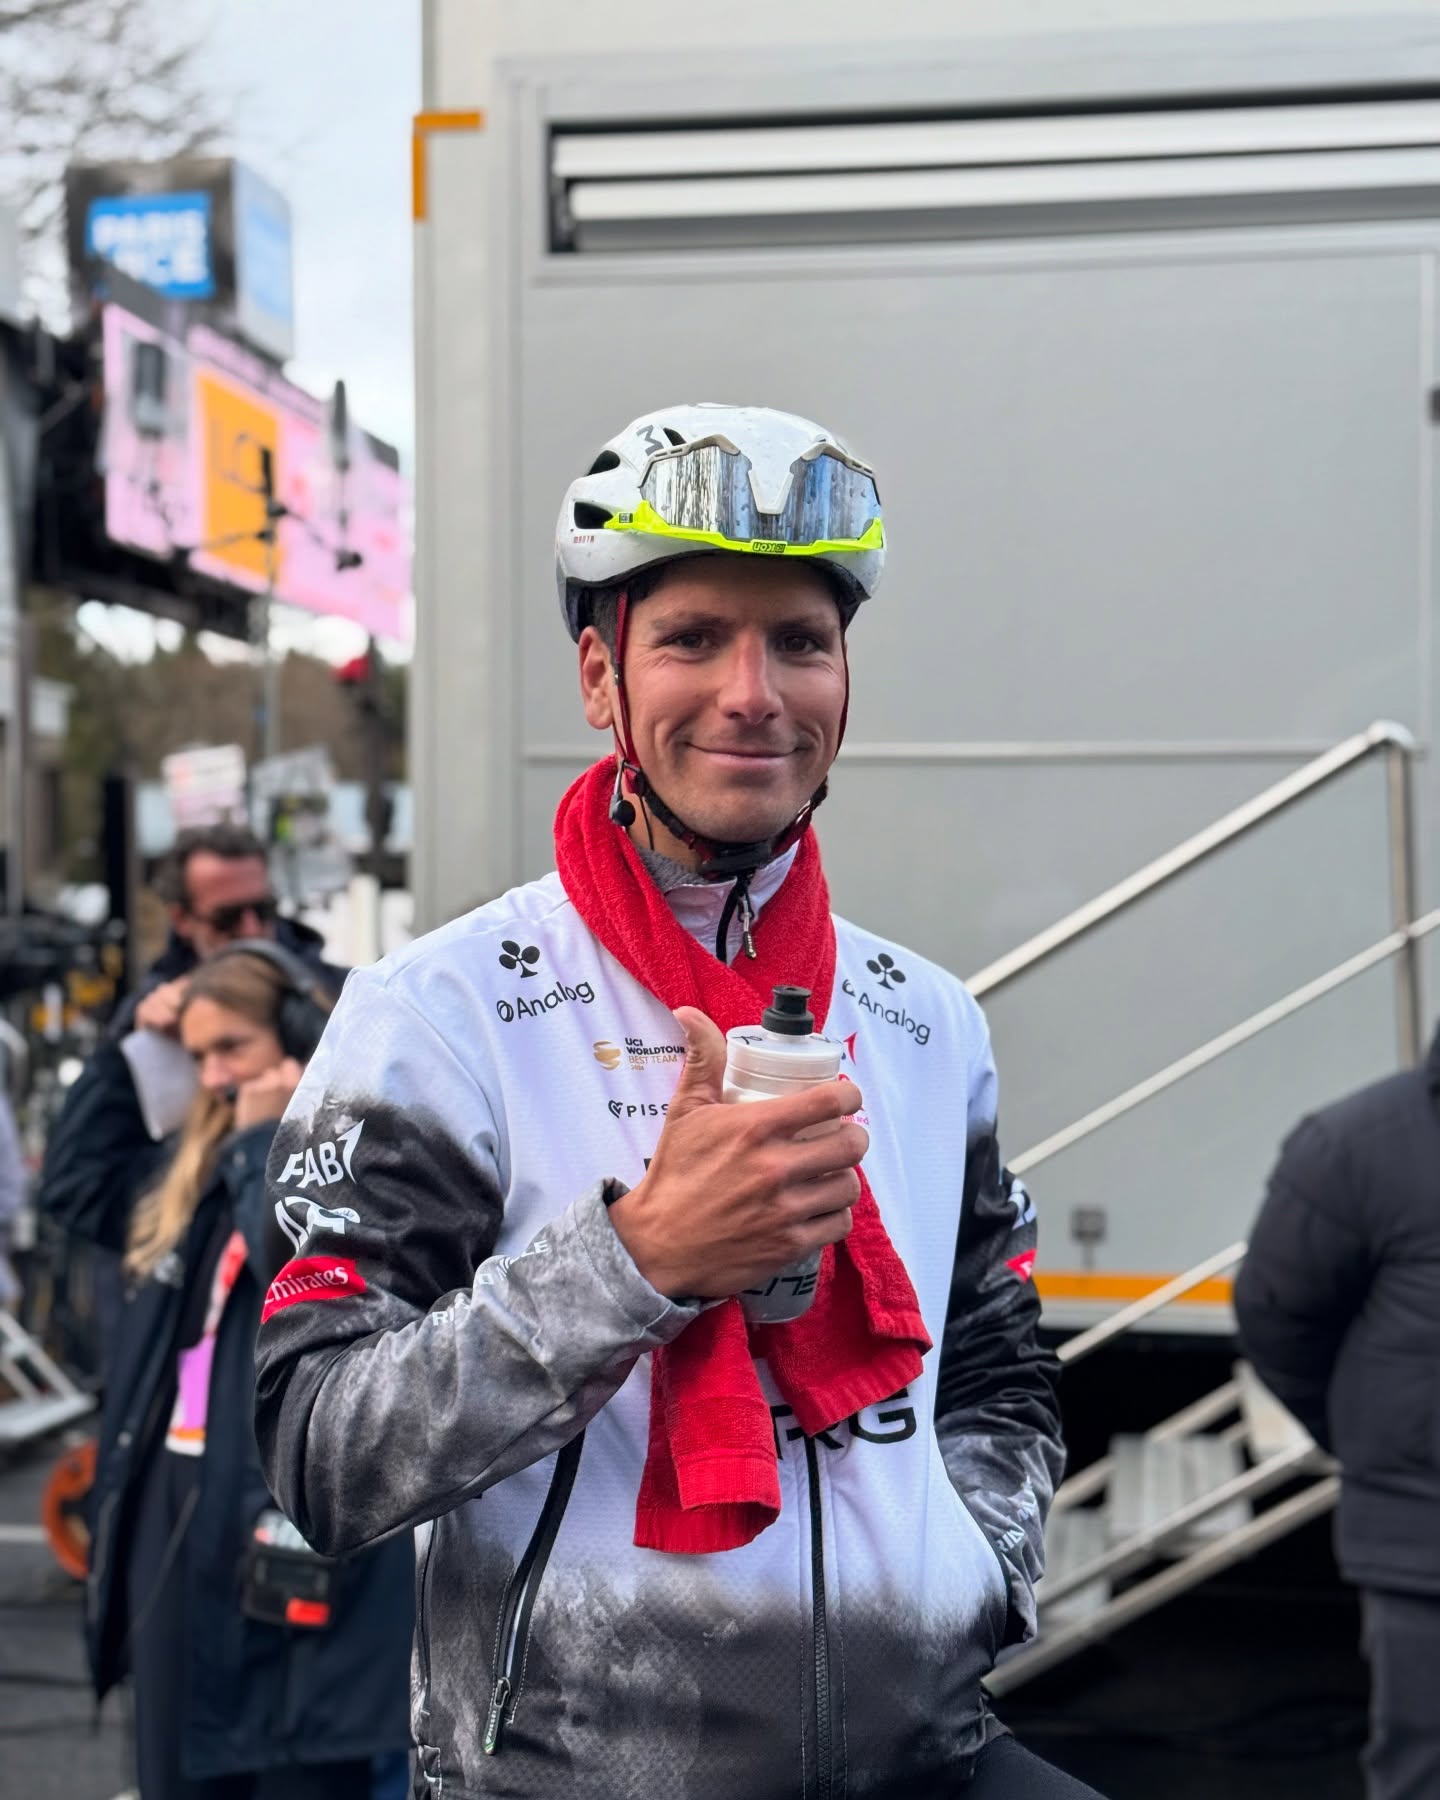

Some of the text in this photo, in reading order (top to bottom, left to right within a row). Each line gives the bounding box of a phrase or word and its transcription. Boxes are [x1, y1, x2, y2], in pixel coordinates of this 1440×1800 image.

[517, 981, 595, 1019] Analog
[858, 993, 931, 1045] Analog
[625, 1037, 643, 1047] UCI
[626, 1045, 686, 1055] WORLDTOUR
[628, 1054, 678, 1064] BEST TEAM
[626, 1103, 669, 1118] PISS
[276, 1141, 344, 1189] FAB
[769, 1387, 917, 1460] RG
